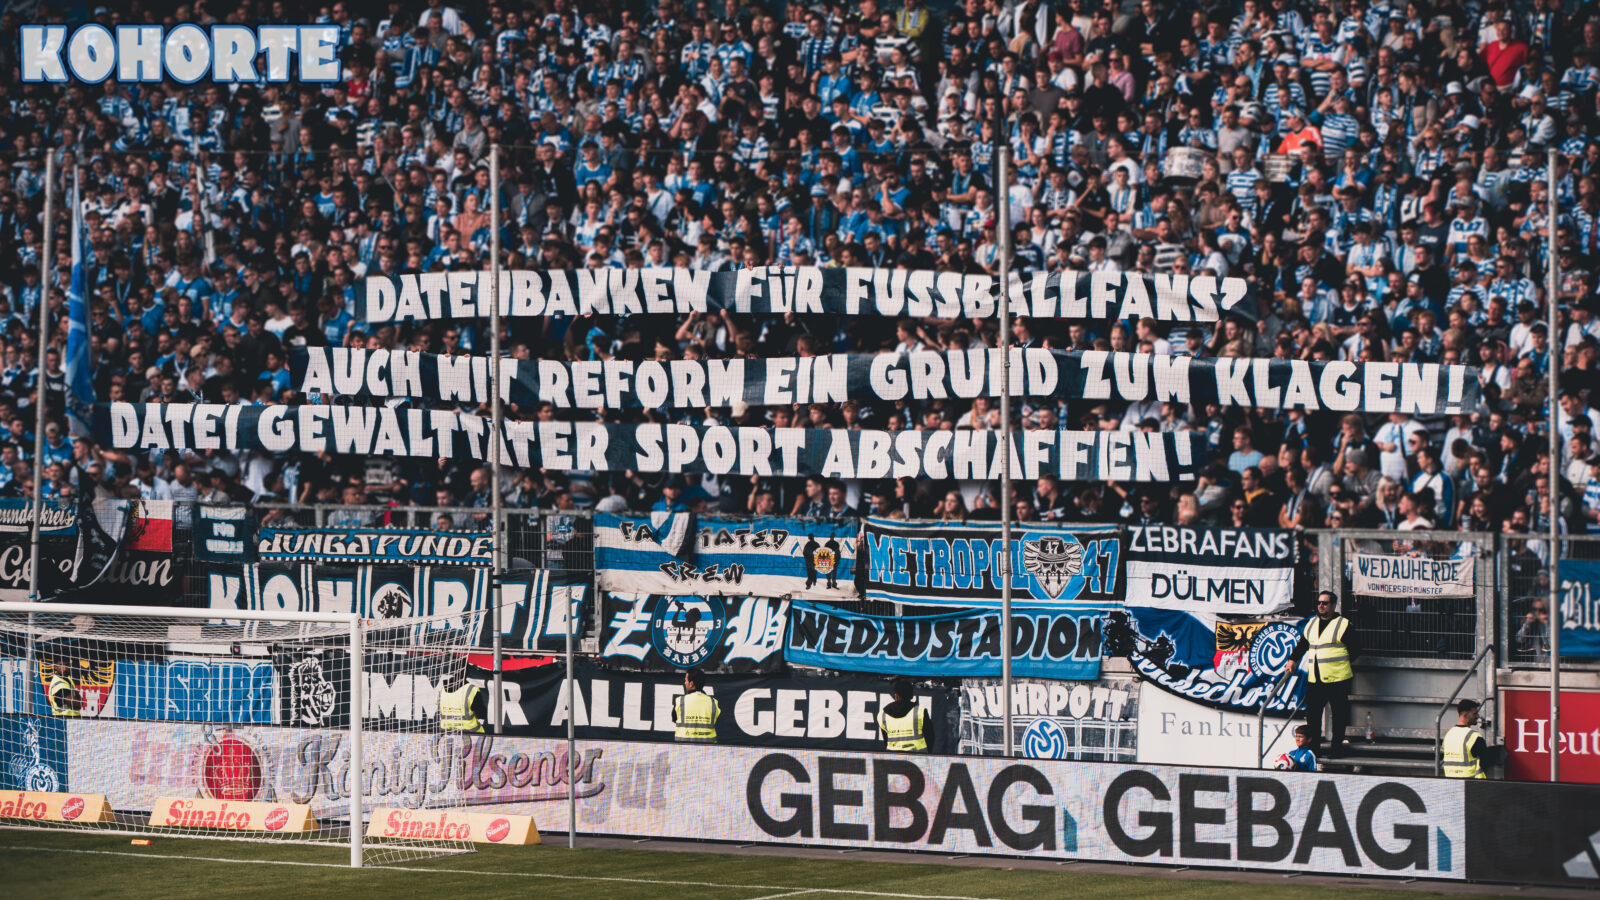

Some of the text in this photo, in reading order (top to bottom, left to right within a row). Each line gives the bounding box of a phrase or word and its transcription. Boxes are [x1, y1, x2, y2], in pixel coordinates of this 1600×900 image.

[366, 266, 1247, 322] DATENBANKEN FÜR FUSSBALLFANS?
[300, 346, 1466, 415] AUCH MIT REFORM EIN GRUND ZUM KLAGEN!
[110, 402, 242, 449] DATEI
[635, 423, 805, 476] SPORT
[821, 428, 1195, 481] ABSCHAFFEN!
[1045, 541, 1059, 555] 47
[1128, 526, 1289, 559] ZEBRAFANS
[866, 531, 1119, 594] METROPOL 47
[1359, 557, 1461, 581] WEDAUHERDE
[1151, 570, 1264, 604] DÜLMEN
[789, 608, 1101, 662] WEDAUSTADION
[1277, 624, 1288, 632] SV
[967, 683, 1128, 722] RUHRPOTT
[166, 800, 250, 830] Sinalco
[746, 752, 1057, 852] GEBAG
[1103, 769, 1429, 871] GEBAG
[384, 810, 470, 840] Sinalco
